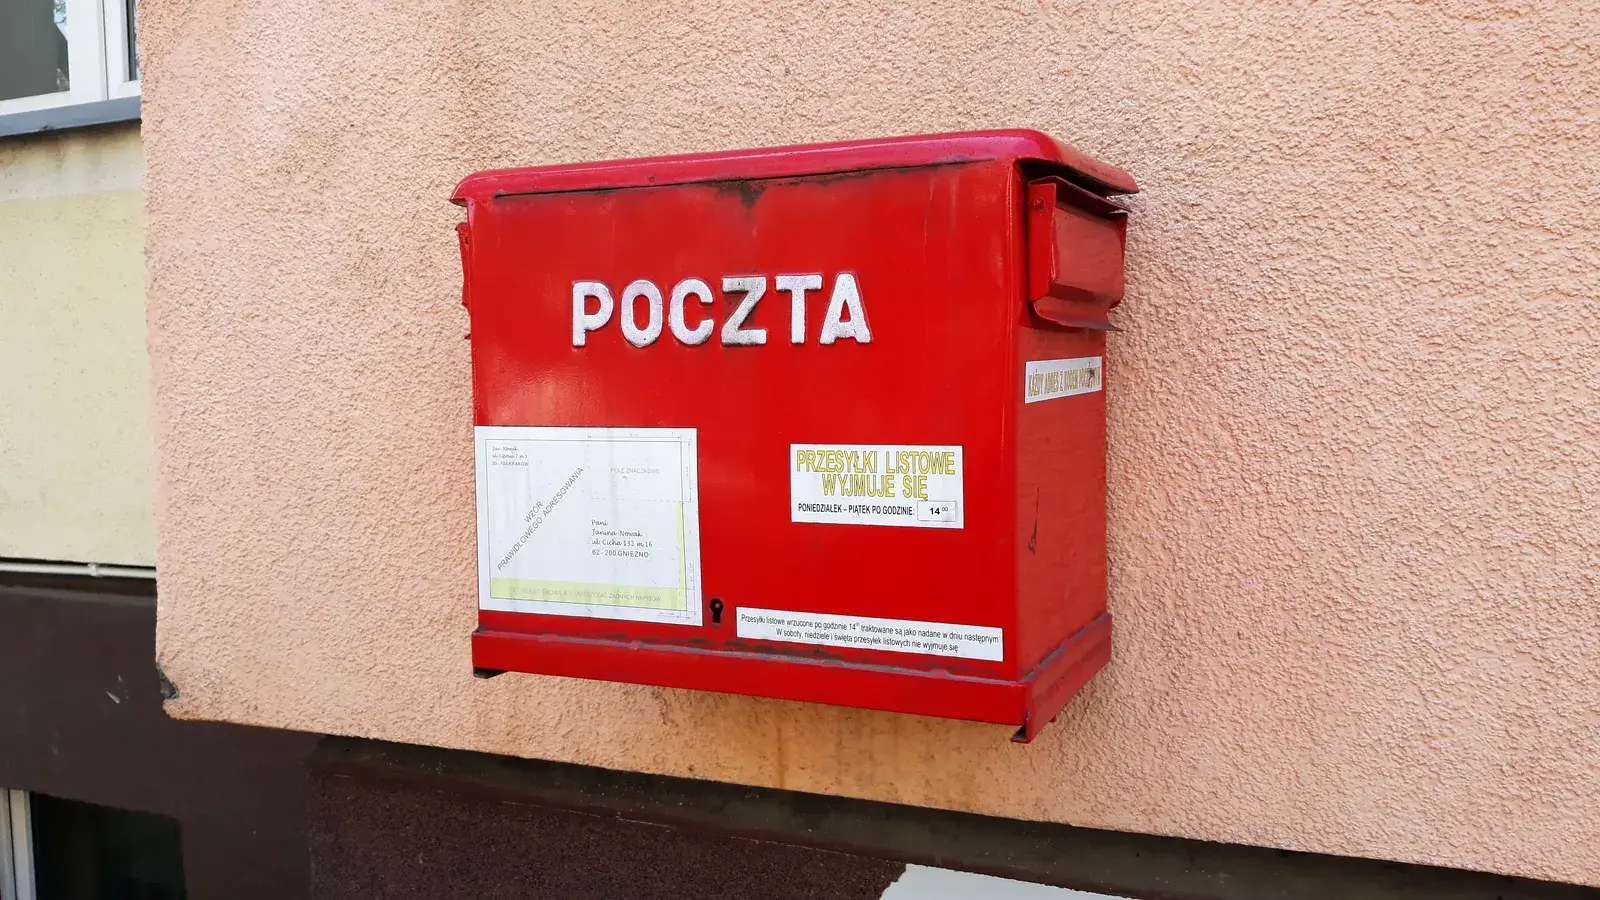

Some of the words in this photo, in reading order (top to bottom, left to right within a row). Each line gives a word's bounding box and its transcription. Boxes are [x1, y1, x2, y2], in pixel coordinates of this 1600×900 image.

[572, 272, 871, 347] POCZTA
[796, 449, 878, 474] PRZESYŁKI
[886, 450, 956, 475] LISTOWE
[542, 466, 584, 518] ADRESOWANIA
[822, 474, 896, 498] WYJMUJE
[902, 475, 928, 502] SIĘ
[798, 502, 842, 513] PONIEDZIAŁEK
[848, 504, 870, 516] PIĄTEK
[872, 505, 882, 514] PO
[882, 506, 916, 516] GODZINIE:
[618, 550, 650, 558] GNIEZNO
[741, 613, 766, 624] Przesyłki
[766, 616, 786, 625] listowe
[786, 619, 813, 628] wrzucone
[814, 620, 822, 629] po
[822, 622, 848, 631] godzinie
[860, 624, 894, 634] traktowane
[894, 626, 904, 637] są
[904, 628, 917, 638] jako
[918, 629, 941, 638] nadane
[948, 631, 963, 640] dniu
[964, 633, 999, 644] następnym
[776, 628, 782, 636] W
[784, 629, 804, 640] soboty,
[804, 631, 830, 640] niedziele
[834, 634, 853, 643] święta
[854, 636, 882, 646] przesyłek
[882, 638, 911, 648] listowych
[912, 640, 922, 648] nie
[922, 642, 948, 652] wyjmuje
[949, 644, 959, 653] się
